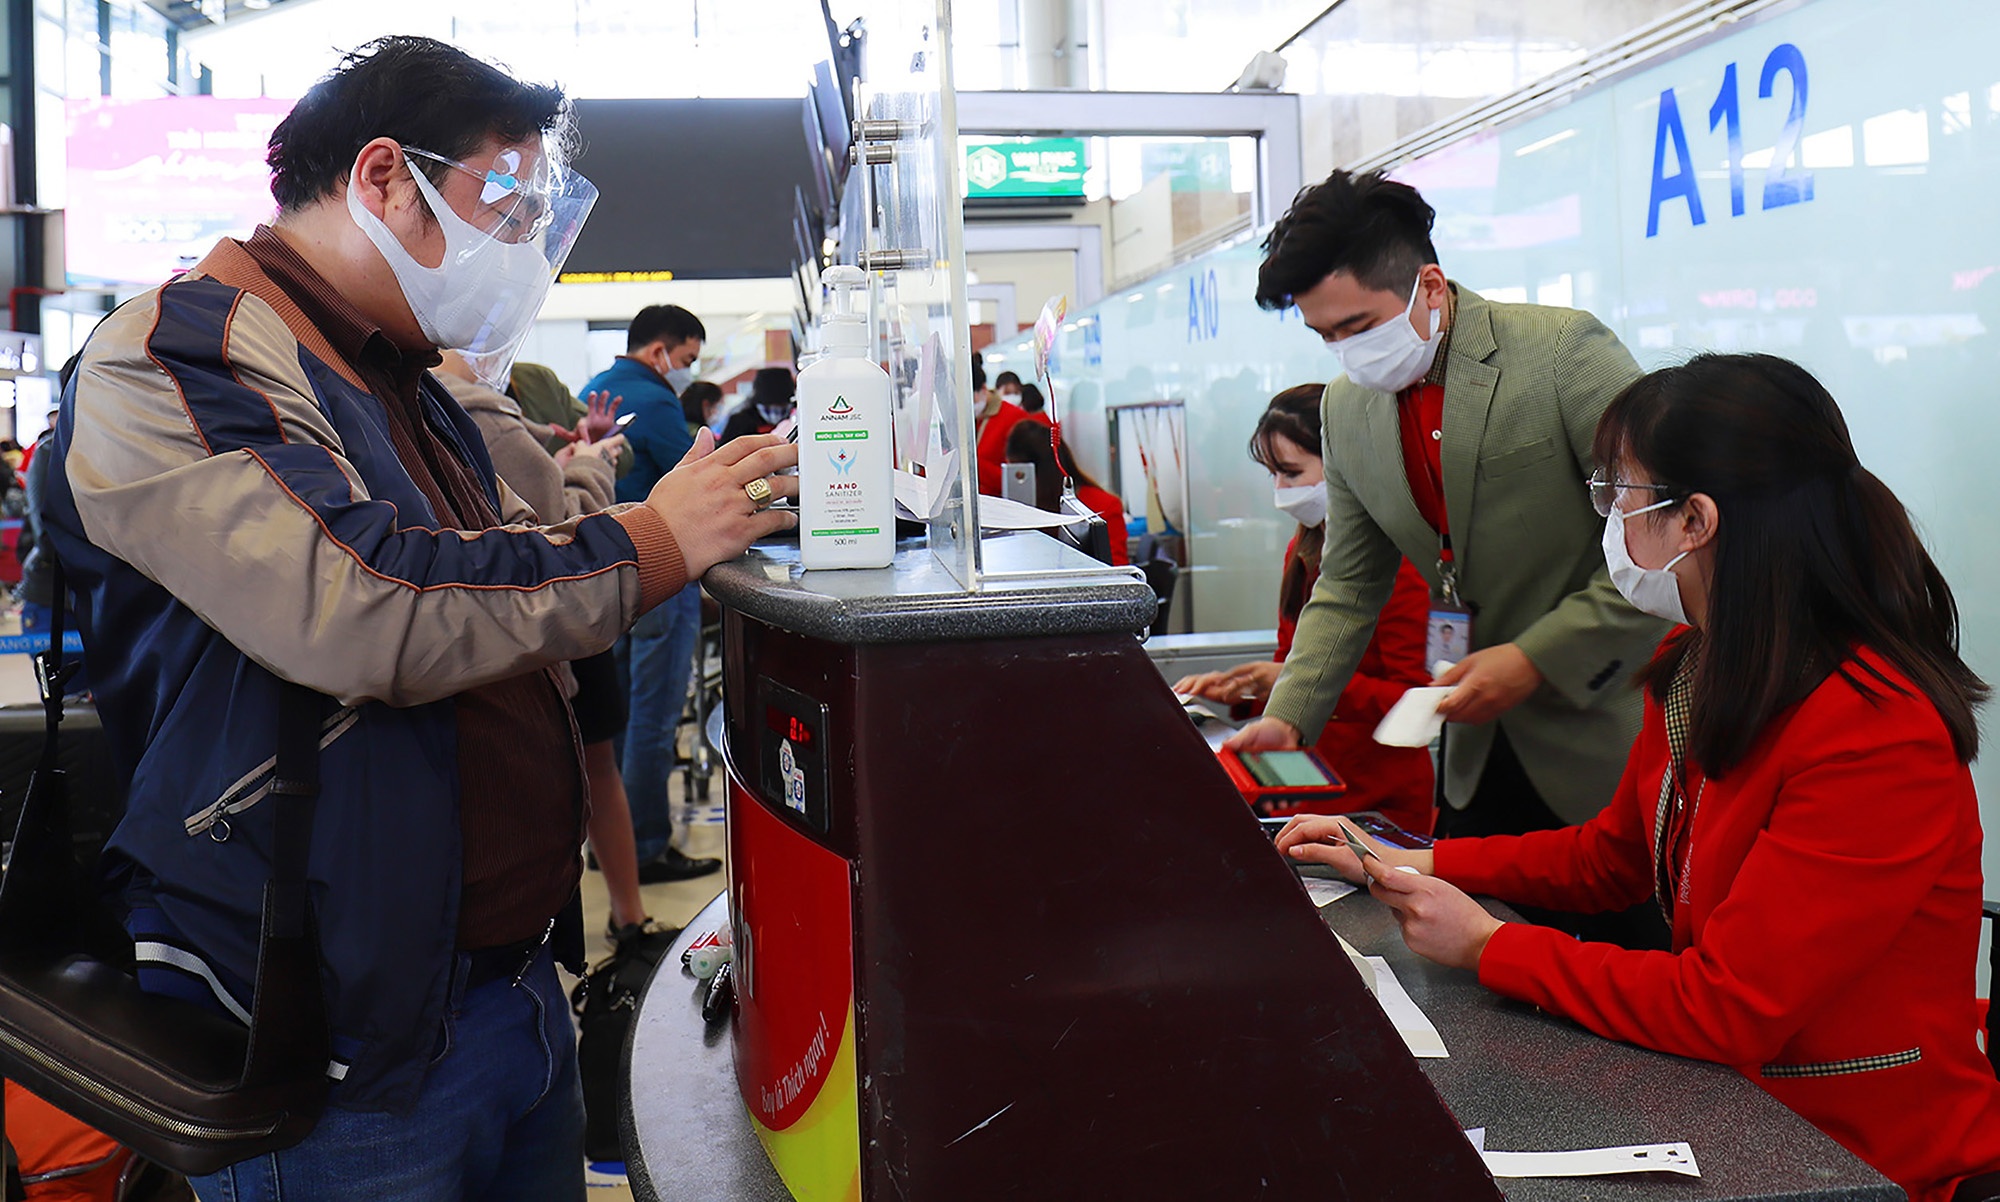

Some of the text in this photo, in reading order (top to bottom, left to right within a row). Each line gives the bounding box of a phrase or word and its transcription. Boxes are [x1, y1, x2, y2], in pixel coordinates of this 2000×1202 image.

[1646, 43, 1815, 238] A12
[1187, 269, 1219, 344] A10
[829, 482, 858, 490] HAND
[834, 538, 847, 546] 500
[761, 1084, 776, 1119] Bay
[774, 1079, 785, 1111] là
[782, 1061, 806, 1105] Thích
